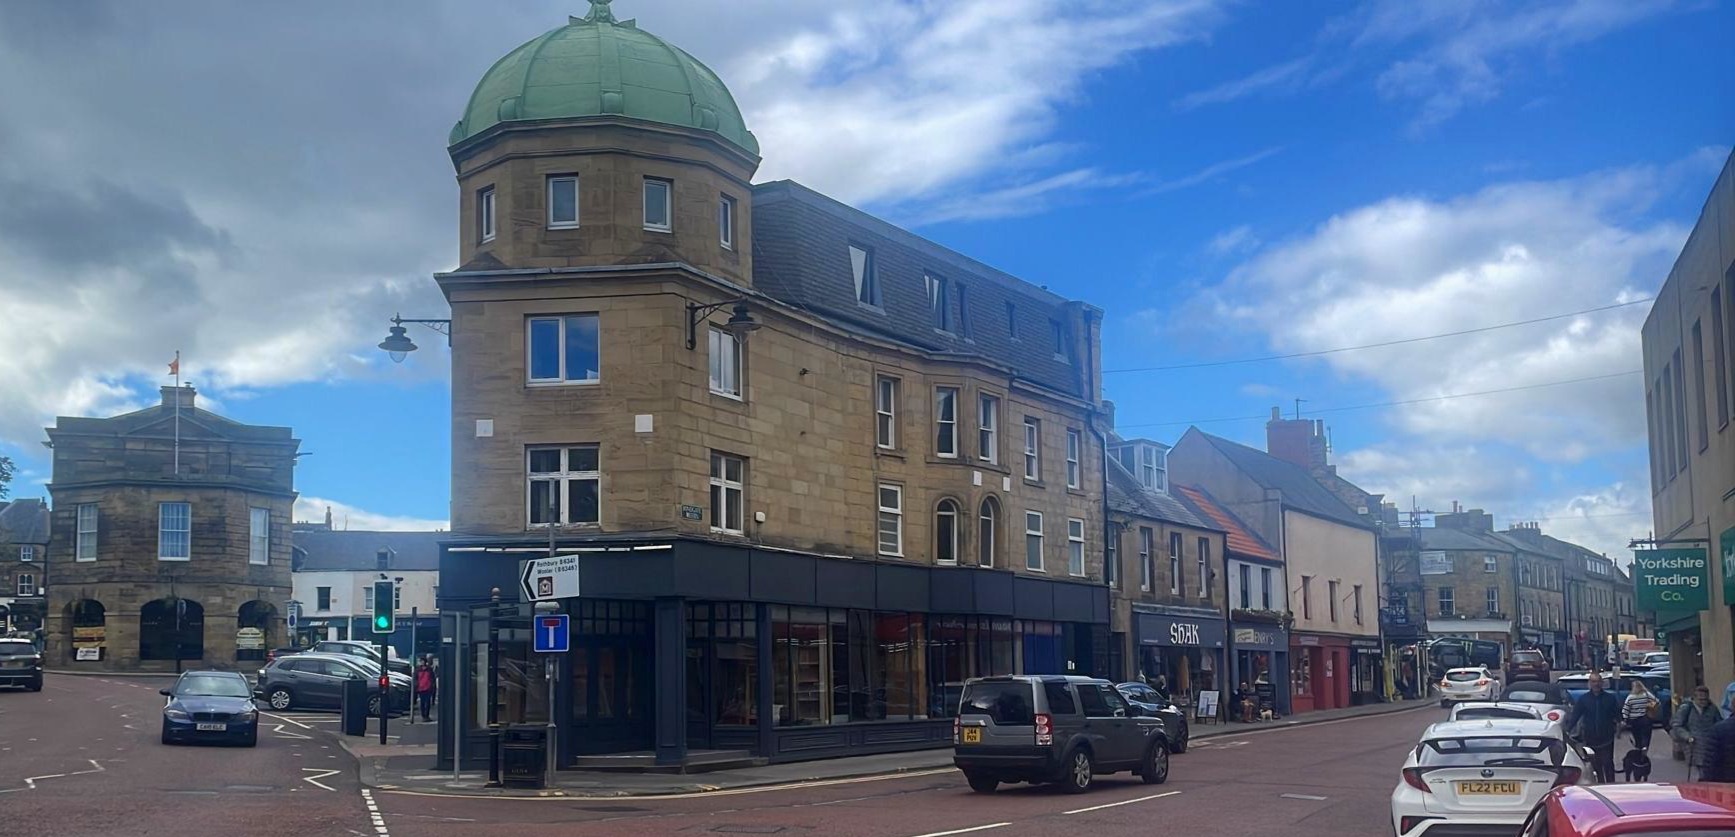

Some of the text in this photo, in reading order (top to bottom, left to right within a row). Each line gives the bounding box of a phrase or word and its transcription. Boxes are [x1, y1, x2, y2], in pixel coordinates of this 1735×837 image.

[1639, 557, 1704, 569] Yorkshire
[1645, 574, 1700, 587] Trading
[1661, 590, 1684, 601] Co.
[1461, 783, 1516, 793] FL22 FCU
